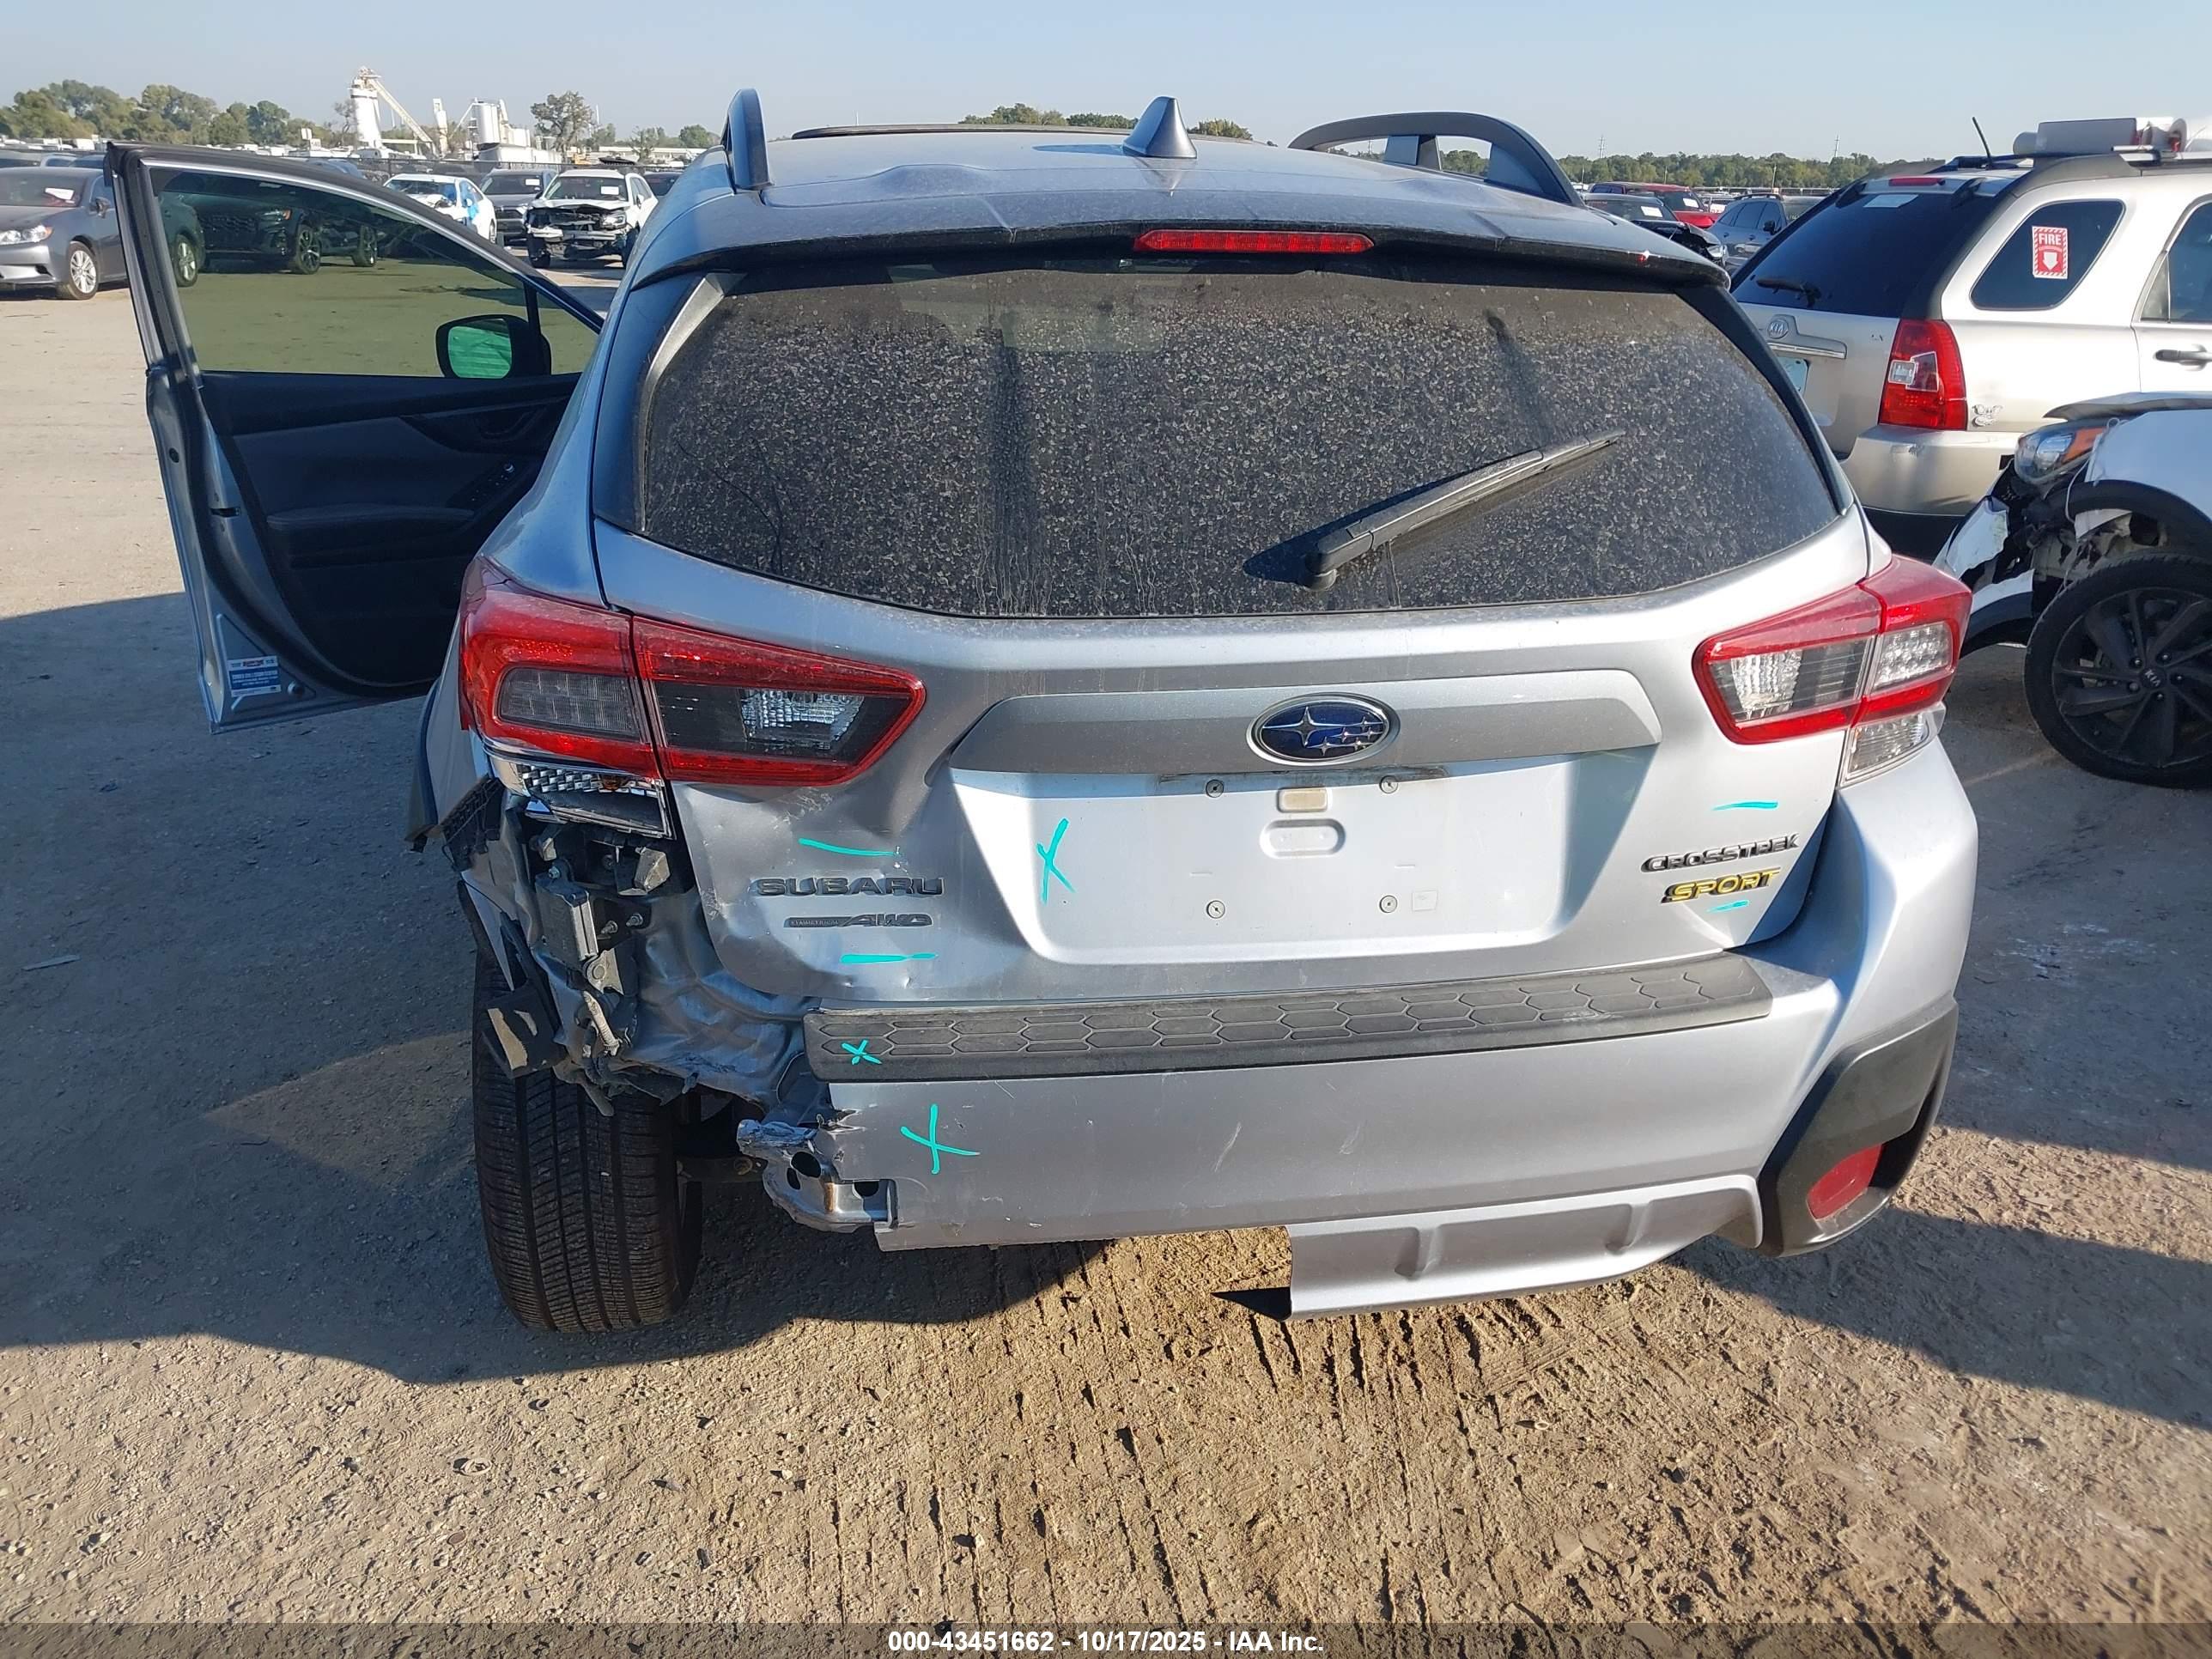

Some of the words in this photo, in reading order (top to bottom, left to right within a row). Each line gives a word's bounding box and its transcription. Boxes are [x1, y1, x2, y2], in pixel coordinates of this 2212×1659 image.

[2038, 233, 2063, 246] FIRE
[1770, 322, 1784, 332] KIA
[2145, 669, 2160, 687] KIA
[1641, 832, 1801, 872] CROSSTREK
[757, 876, 945, 896] SUBARU
[1661, 867, 1781, 903] SPORT
[840, 913, 933, 928] AWD
